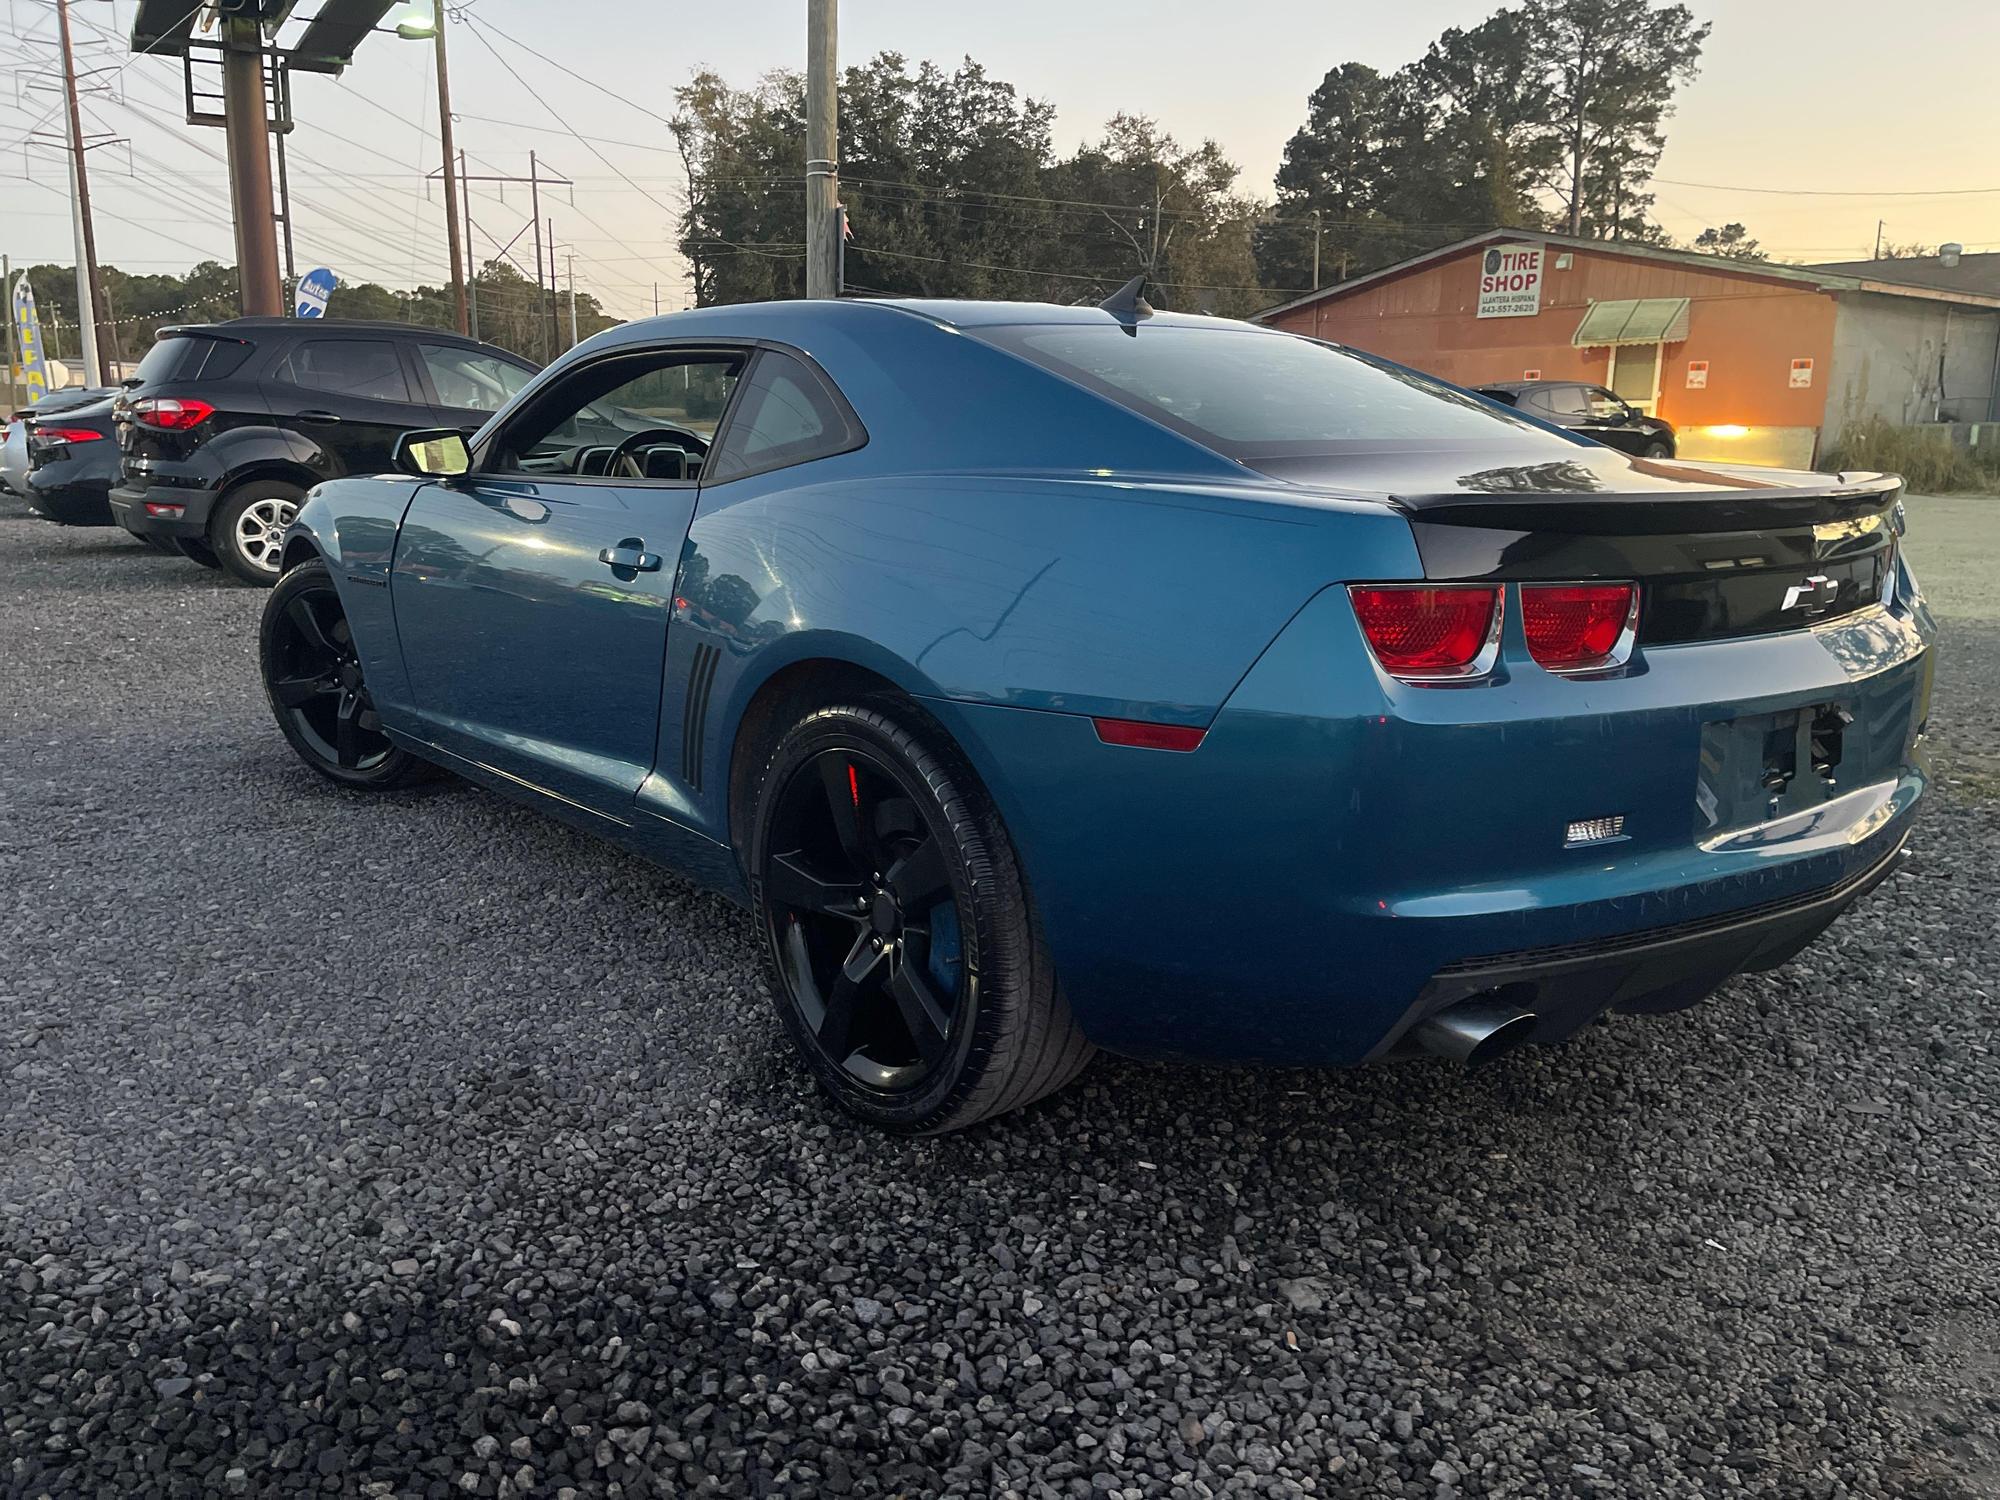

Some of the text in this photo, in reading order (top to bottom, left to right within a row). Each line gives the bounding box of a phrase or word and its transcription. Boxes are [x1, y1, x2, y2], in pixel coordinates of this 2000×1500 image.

[1503, 252, 1539, 271] TIRE
[1482, 273, 1537, 293] SHOP
[1482, 295, 1510, 304] LLANTERA
